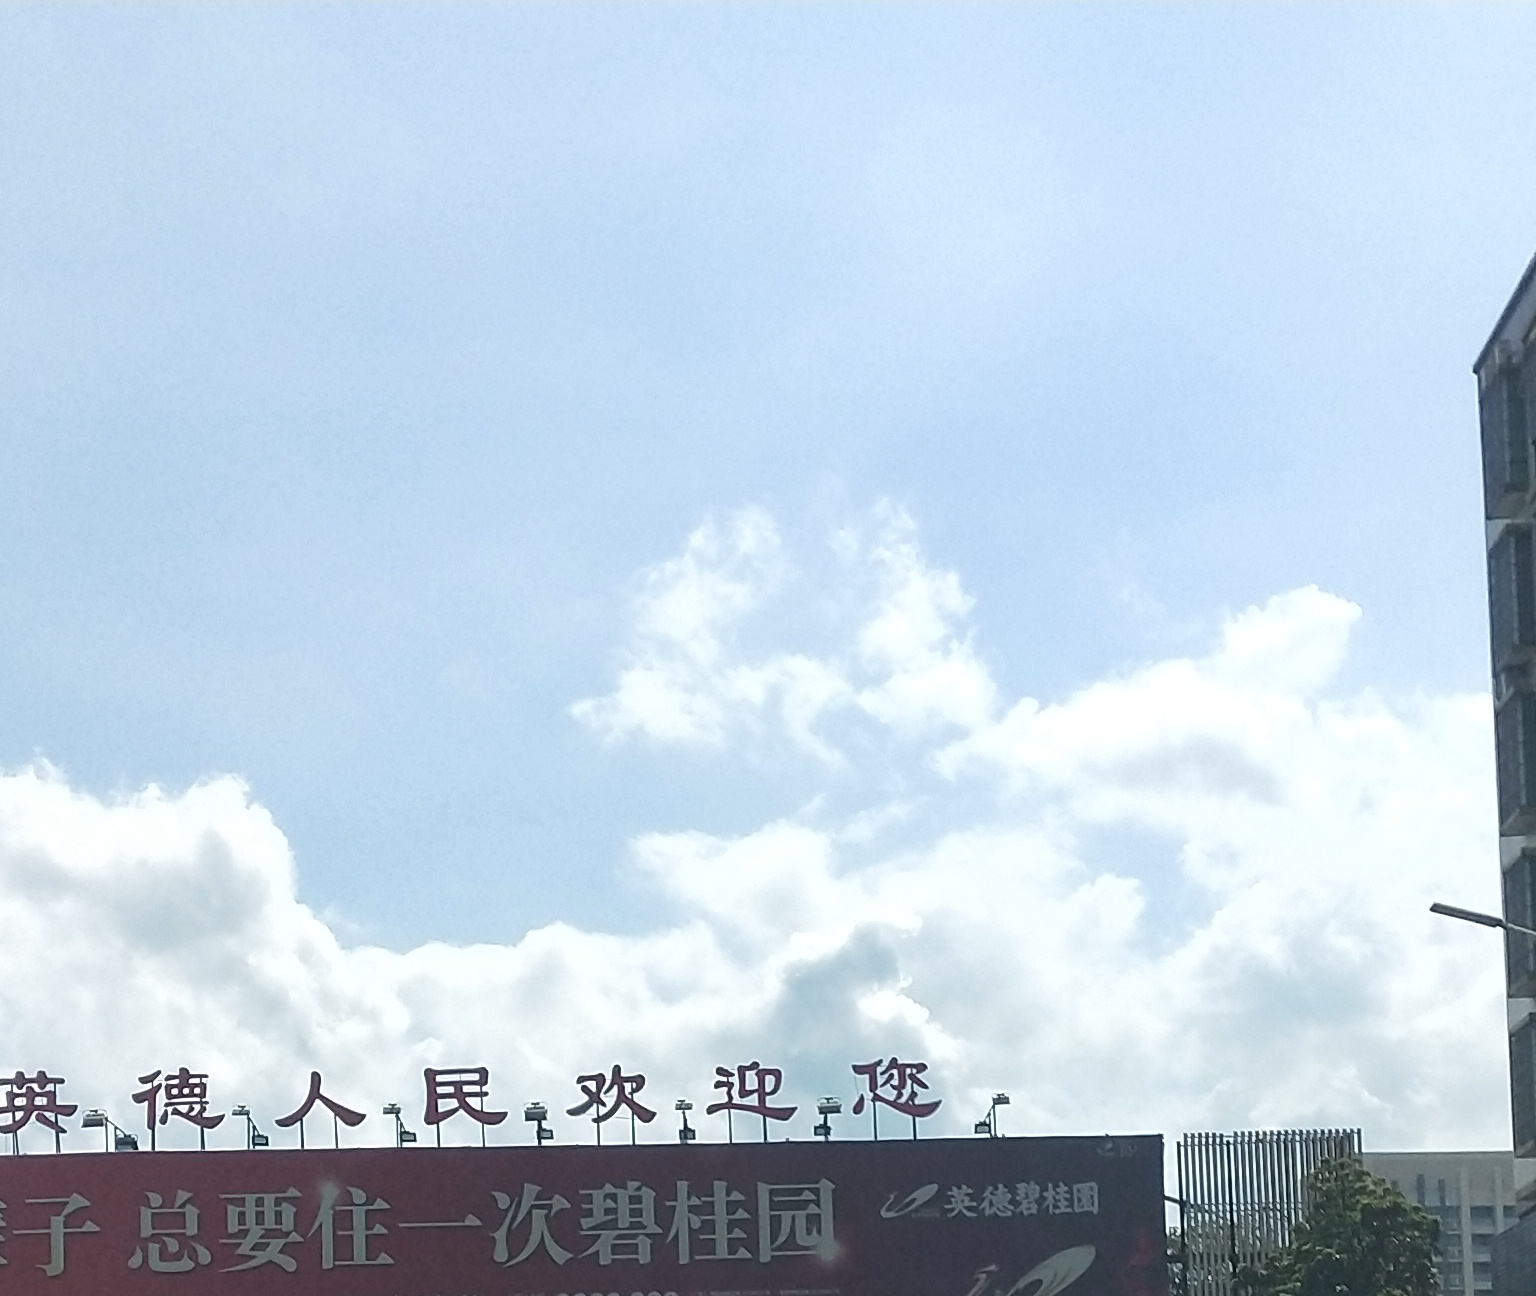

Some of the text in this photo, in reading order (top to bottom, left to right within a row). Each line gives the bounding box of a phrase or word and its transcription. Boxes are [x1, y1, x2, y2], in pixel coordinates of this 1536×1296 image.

[126, 1177, 837, 1275] 总要住一次碧桂园
